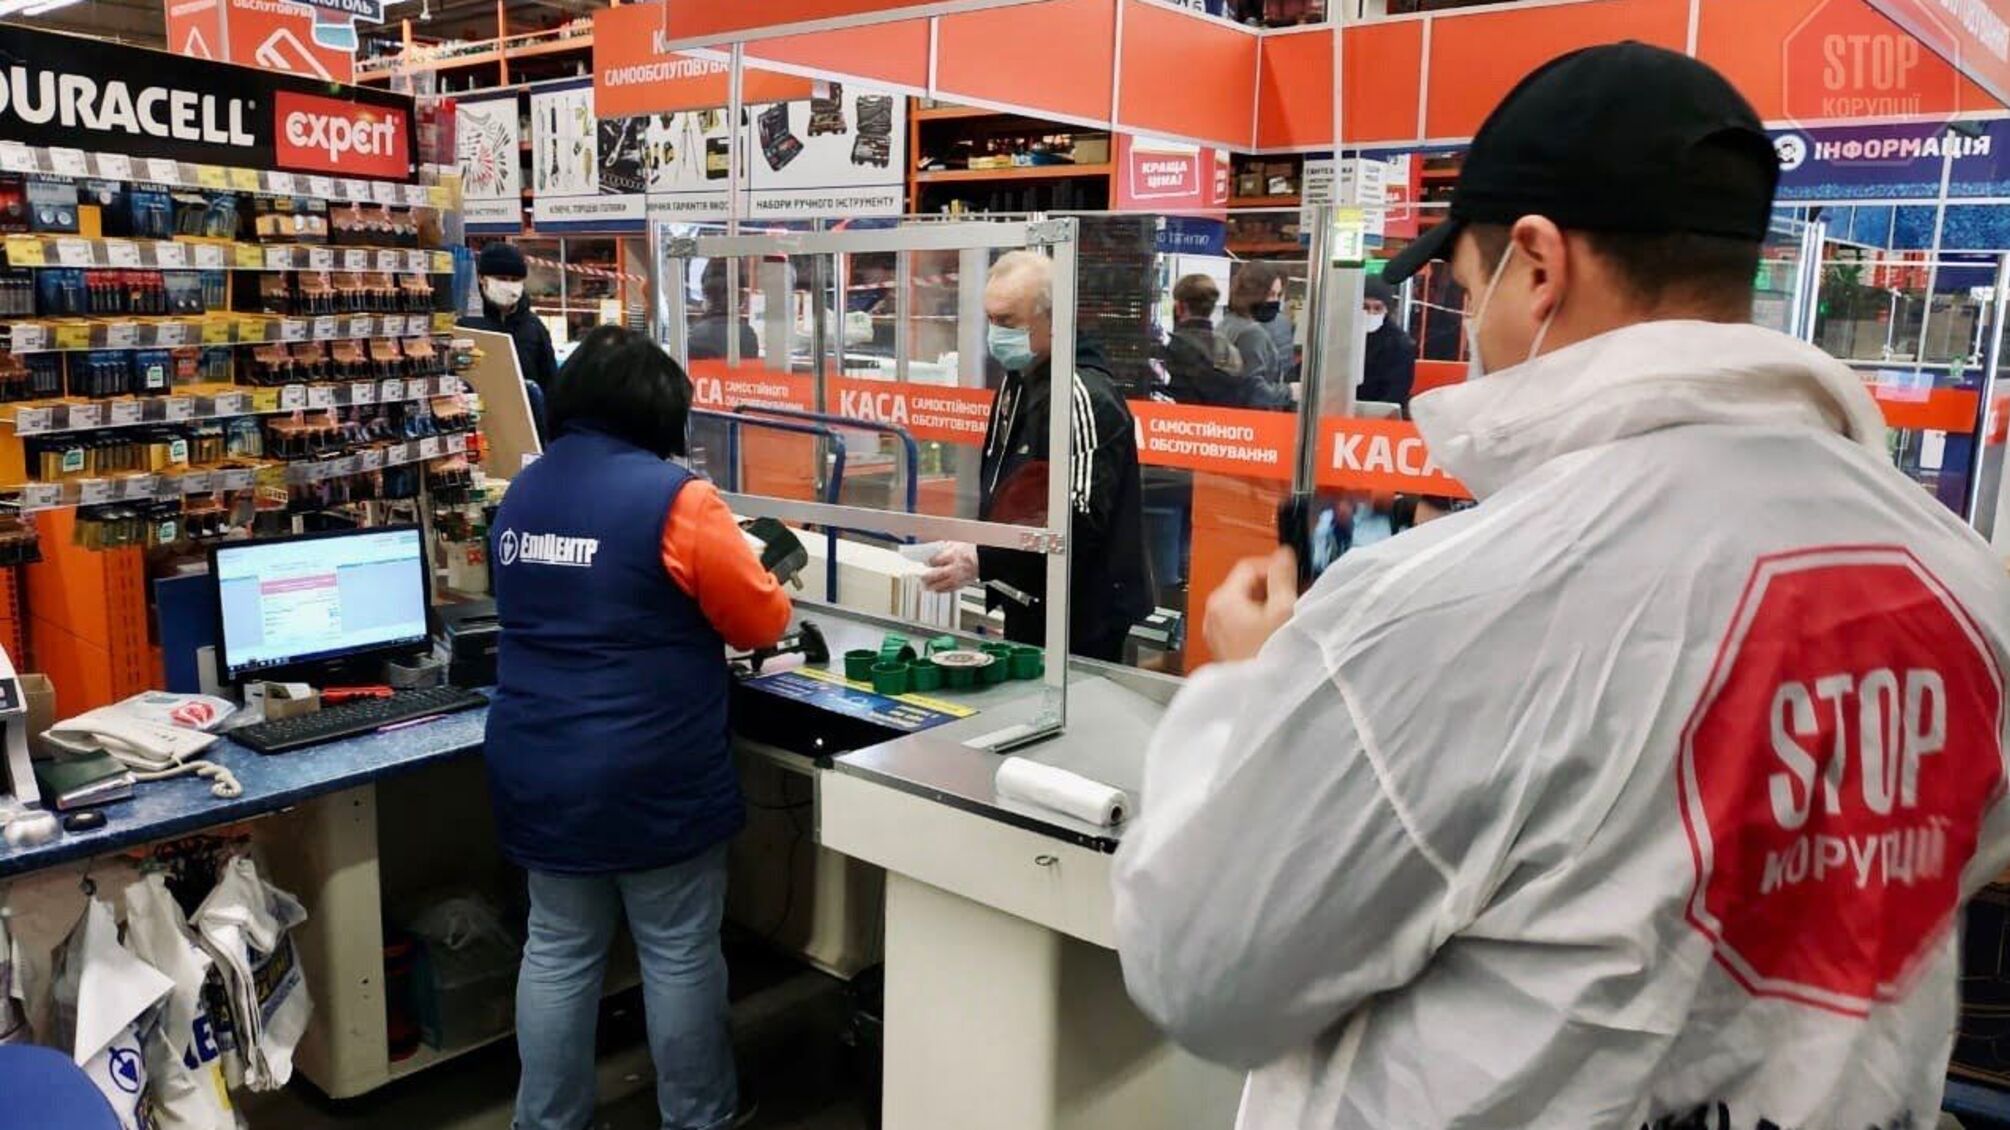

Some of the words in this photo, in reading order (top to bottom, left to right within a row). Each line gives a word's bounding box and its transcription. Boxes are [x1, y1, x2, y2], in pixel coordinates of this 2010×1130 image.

[0, 66, 255, 147] URACELL
[285, 111, 397, 163] expert
[1814, 135, 1991, 161] ІНФОРМАЦІЯ
[1142, 161, 1188, 175] КРАЩА
[1147, 174, 1183, 188] ЦІНА!
[756, 199, 791, 210] НАБОРИ
[794, 198, 833, 209] РУЧНОГО
[836, 196, 894, 208] ІНСТРУМЕНТУ
[840, 389, 909, 425] КАСА
[912, 397, 990, 417] САМОСТІЙНОГО
[911, 413, 988, 433] ОБСЛУГОВУВА
[1149, 418, 1254, 441] САМОСТІЙНОГО
[1149, 437, 1278, 464] ОБСЛУГОВУВАННЯ
[1768, 668, 1946, 830] STOP
[1761, 816, 1952, 896] КОРУПЦІЇ
